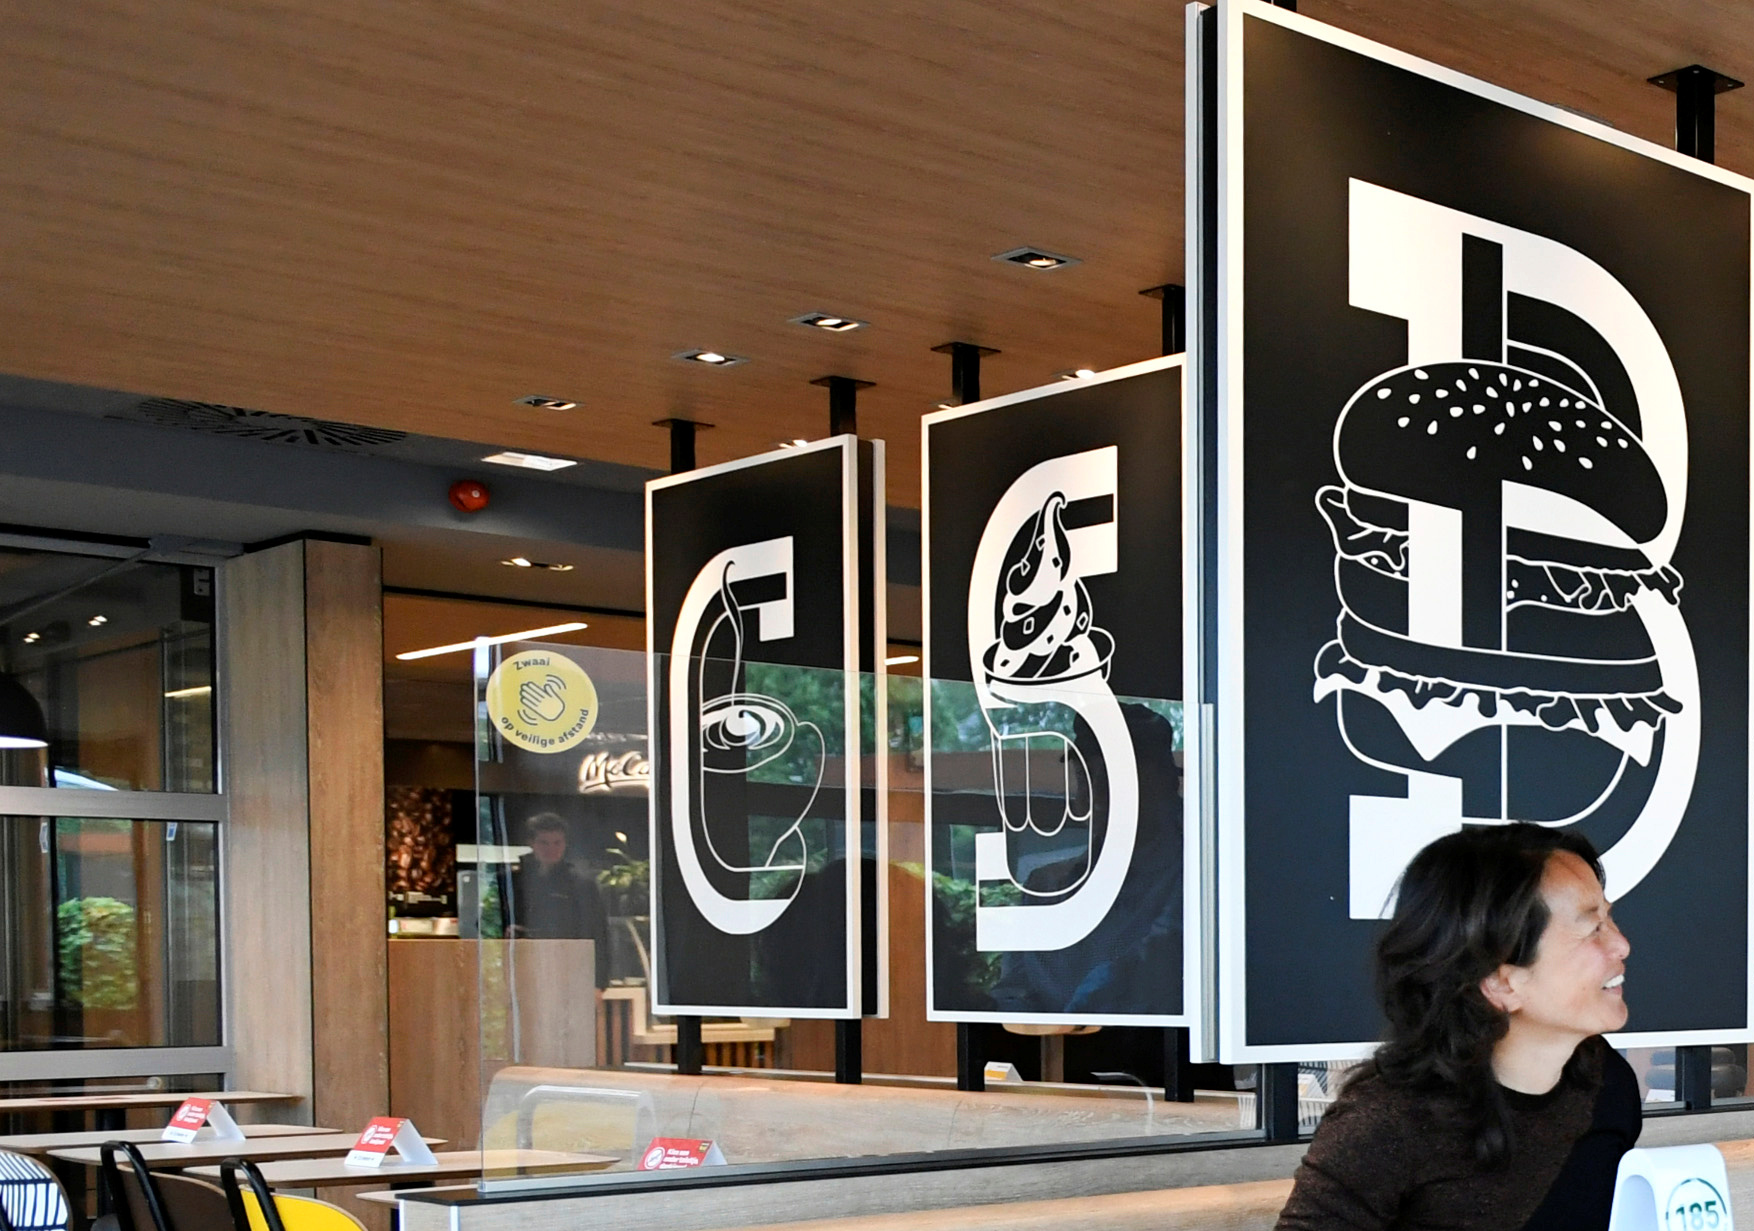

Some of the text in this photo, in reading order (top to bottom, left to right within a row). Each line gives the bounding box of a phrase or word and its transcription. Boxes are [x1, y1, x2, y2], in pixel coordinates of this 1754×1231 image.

[1349, 176, 1701, 920] B
[512, 657, 550, 671] Zwaai
[968, 445, 1139, 951] S
[501, 708, 589, 748] op veilige afstand
[670, 535, 804, 935] C
[579, 751, 648, 793] McCa
[1676, 1201, 1719, 1231] 185
